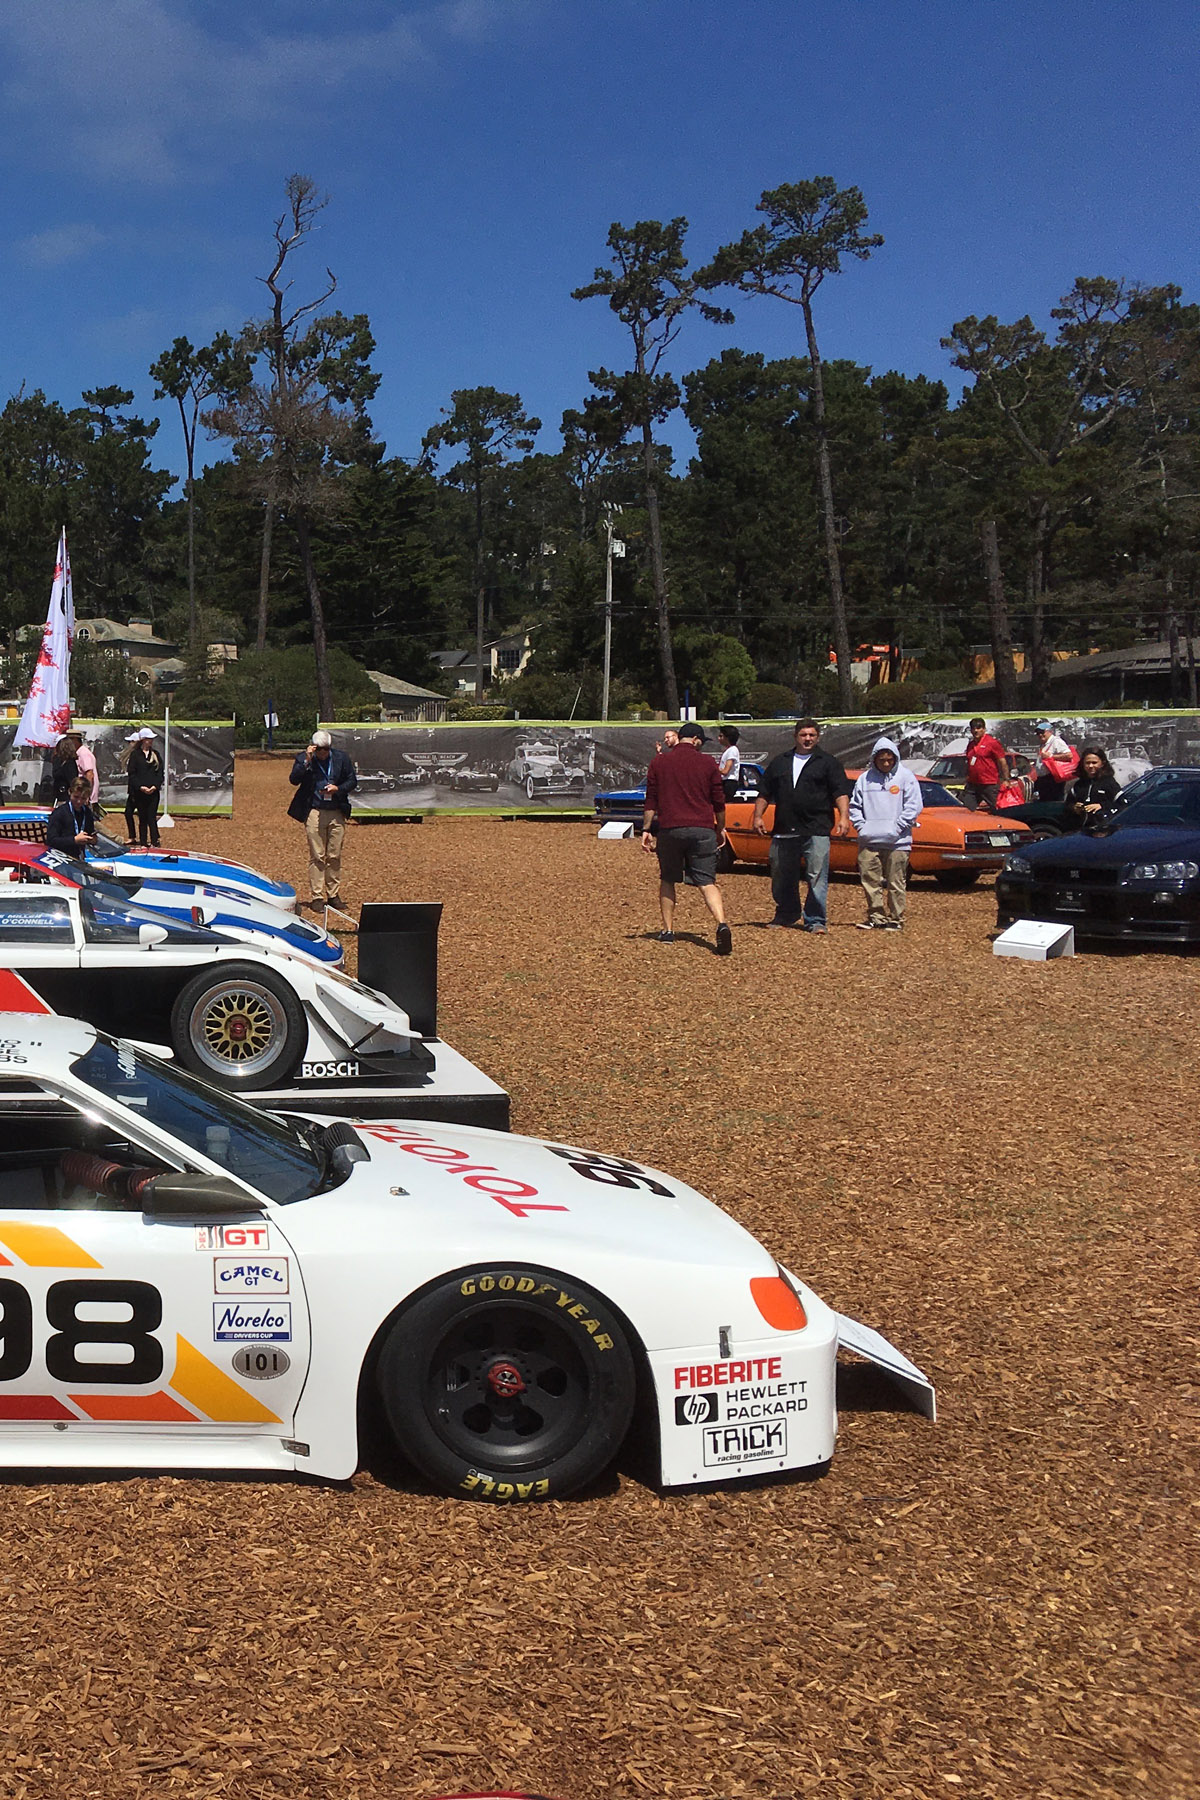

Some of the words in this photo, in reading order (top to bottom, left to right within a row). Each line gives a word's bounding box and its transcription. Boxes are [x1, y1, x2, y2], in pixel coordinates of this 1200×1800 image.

[302, 1061, 360, 1077] BOSCH
[351, 1123, 571, 1218] TOYOTA
[224, 1228, 267, 1246] GT
[219, 1265, 284, 1282] CAMEL
[244, 1276, 260, 1286] GT
[217, 1304, 284, 1331] Norelco
[460, 1274, 616, 1352] GOODYEAR
[245, 1353, 278, 1371] 101
[674, 1356, 782, 1390] FIBERITE
[726, 1380, 808, 1403] HEWLETT
[726, 1398, 808, 1421] PACKARD
[706, 1422, 783, 1455] TRICK
[717, 1453, 742, 1462] racing
[743, 1449, 775, 1460] gasoline
[459, 1474, 550, 1499] EAGLE
